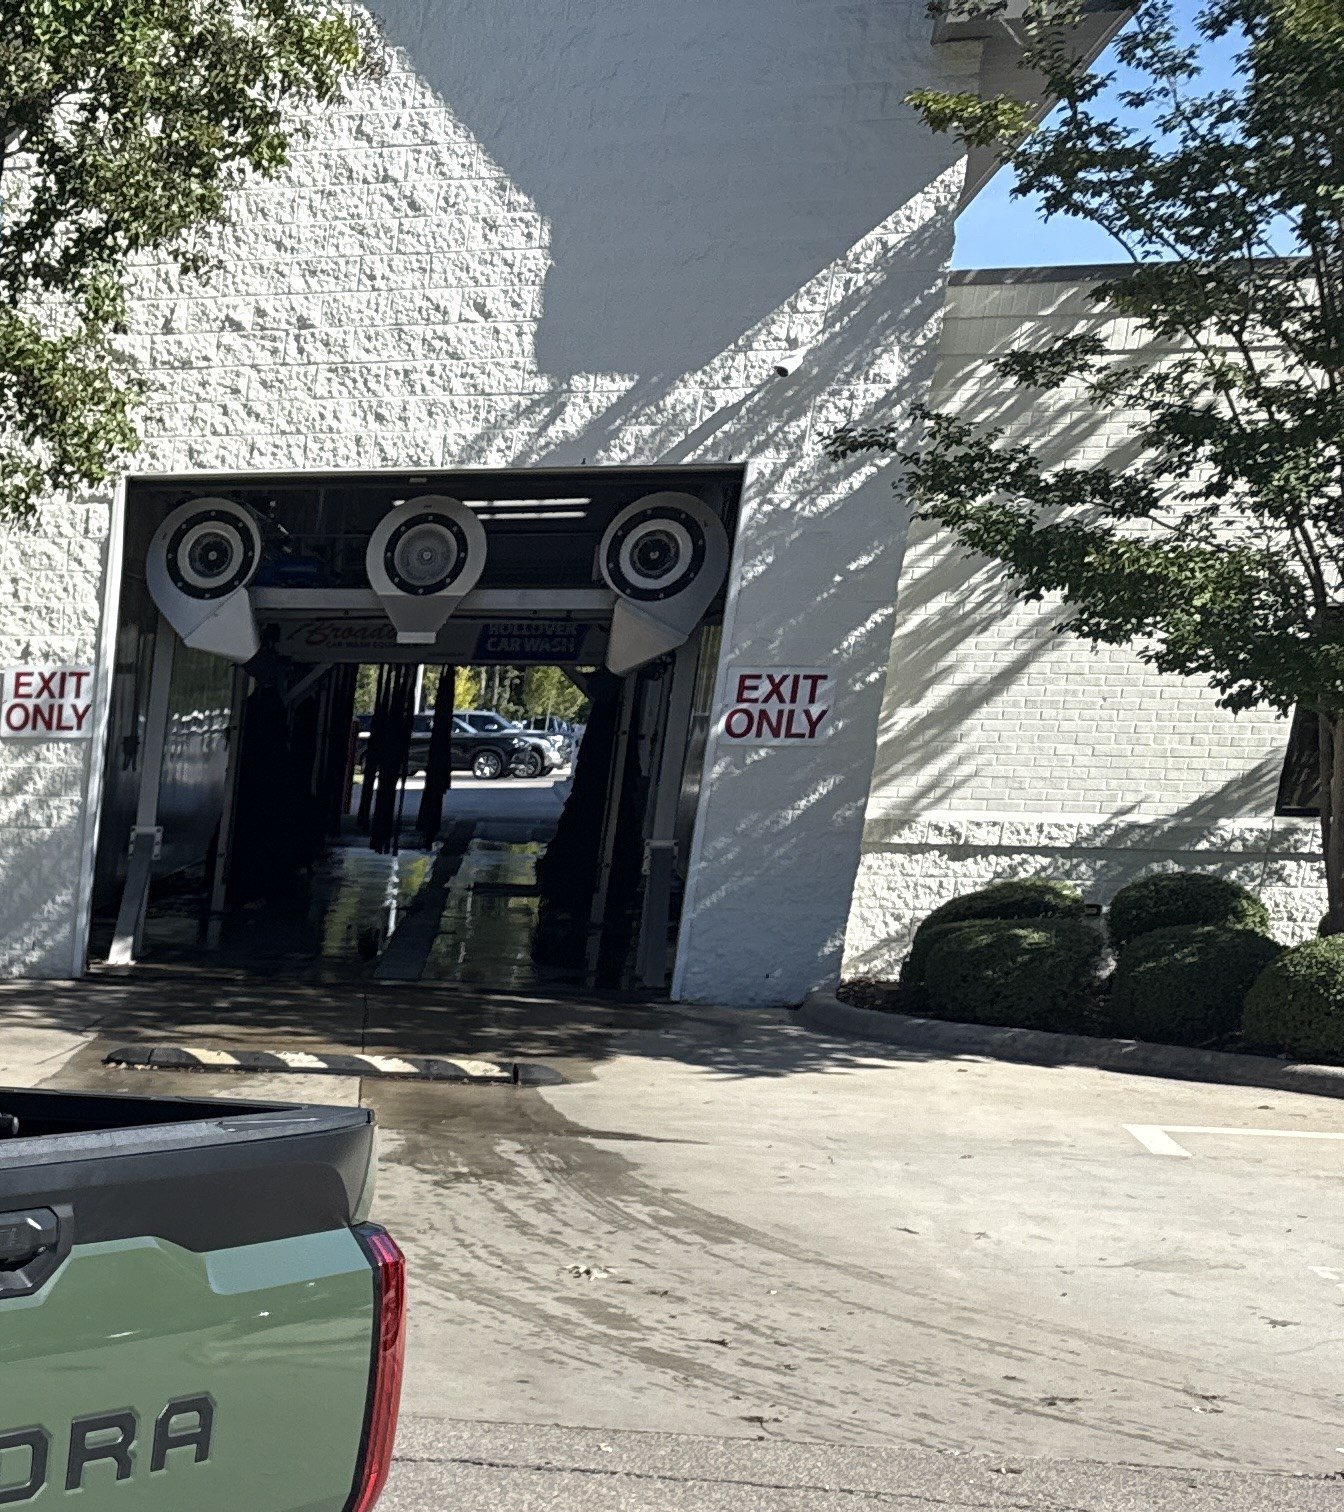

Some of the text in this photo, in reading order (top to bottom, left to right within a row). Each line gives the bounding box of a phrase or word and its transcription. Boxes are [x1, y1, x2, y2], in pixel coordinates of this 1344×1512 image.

[488, 638, 575, 652] CAR WASH
[13, 672, 90, 699] EXIT
[736, 674, 828, 704] EXIT
[5, 703, 92, 731] ONLY
[725, 708, 829, 738] ONLY
